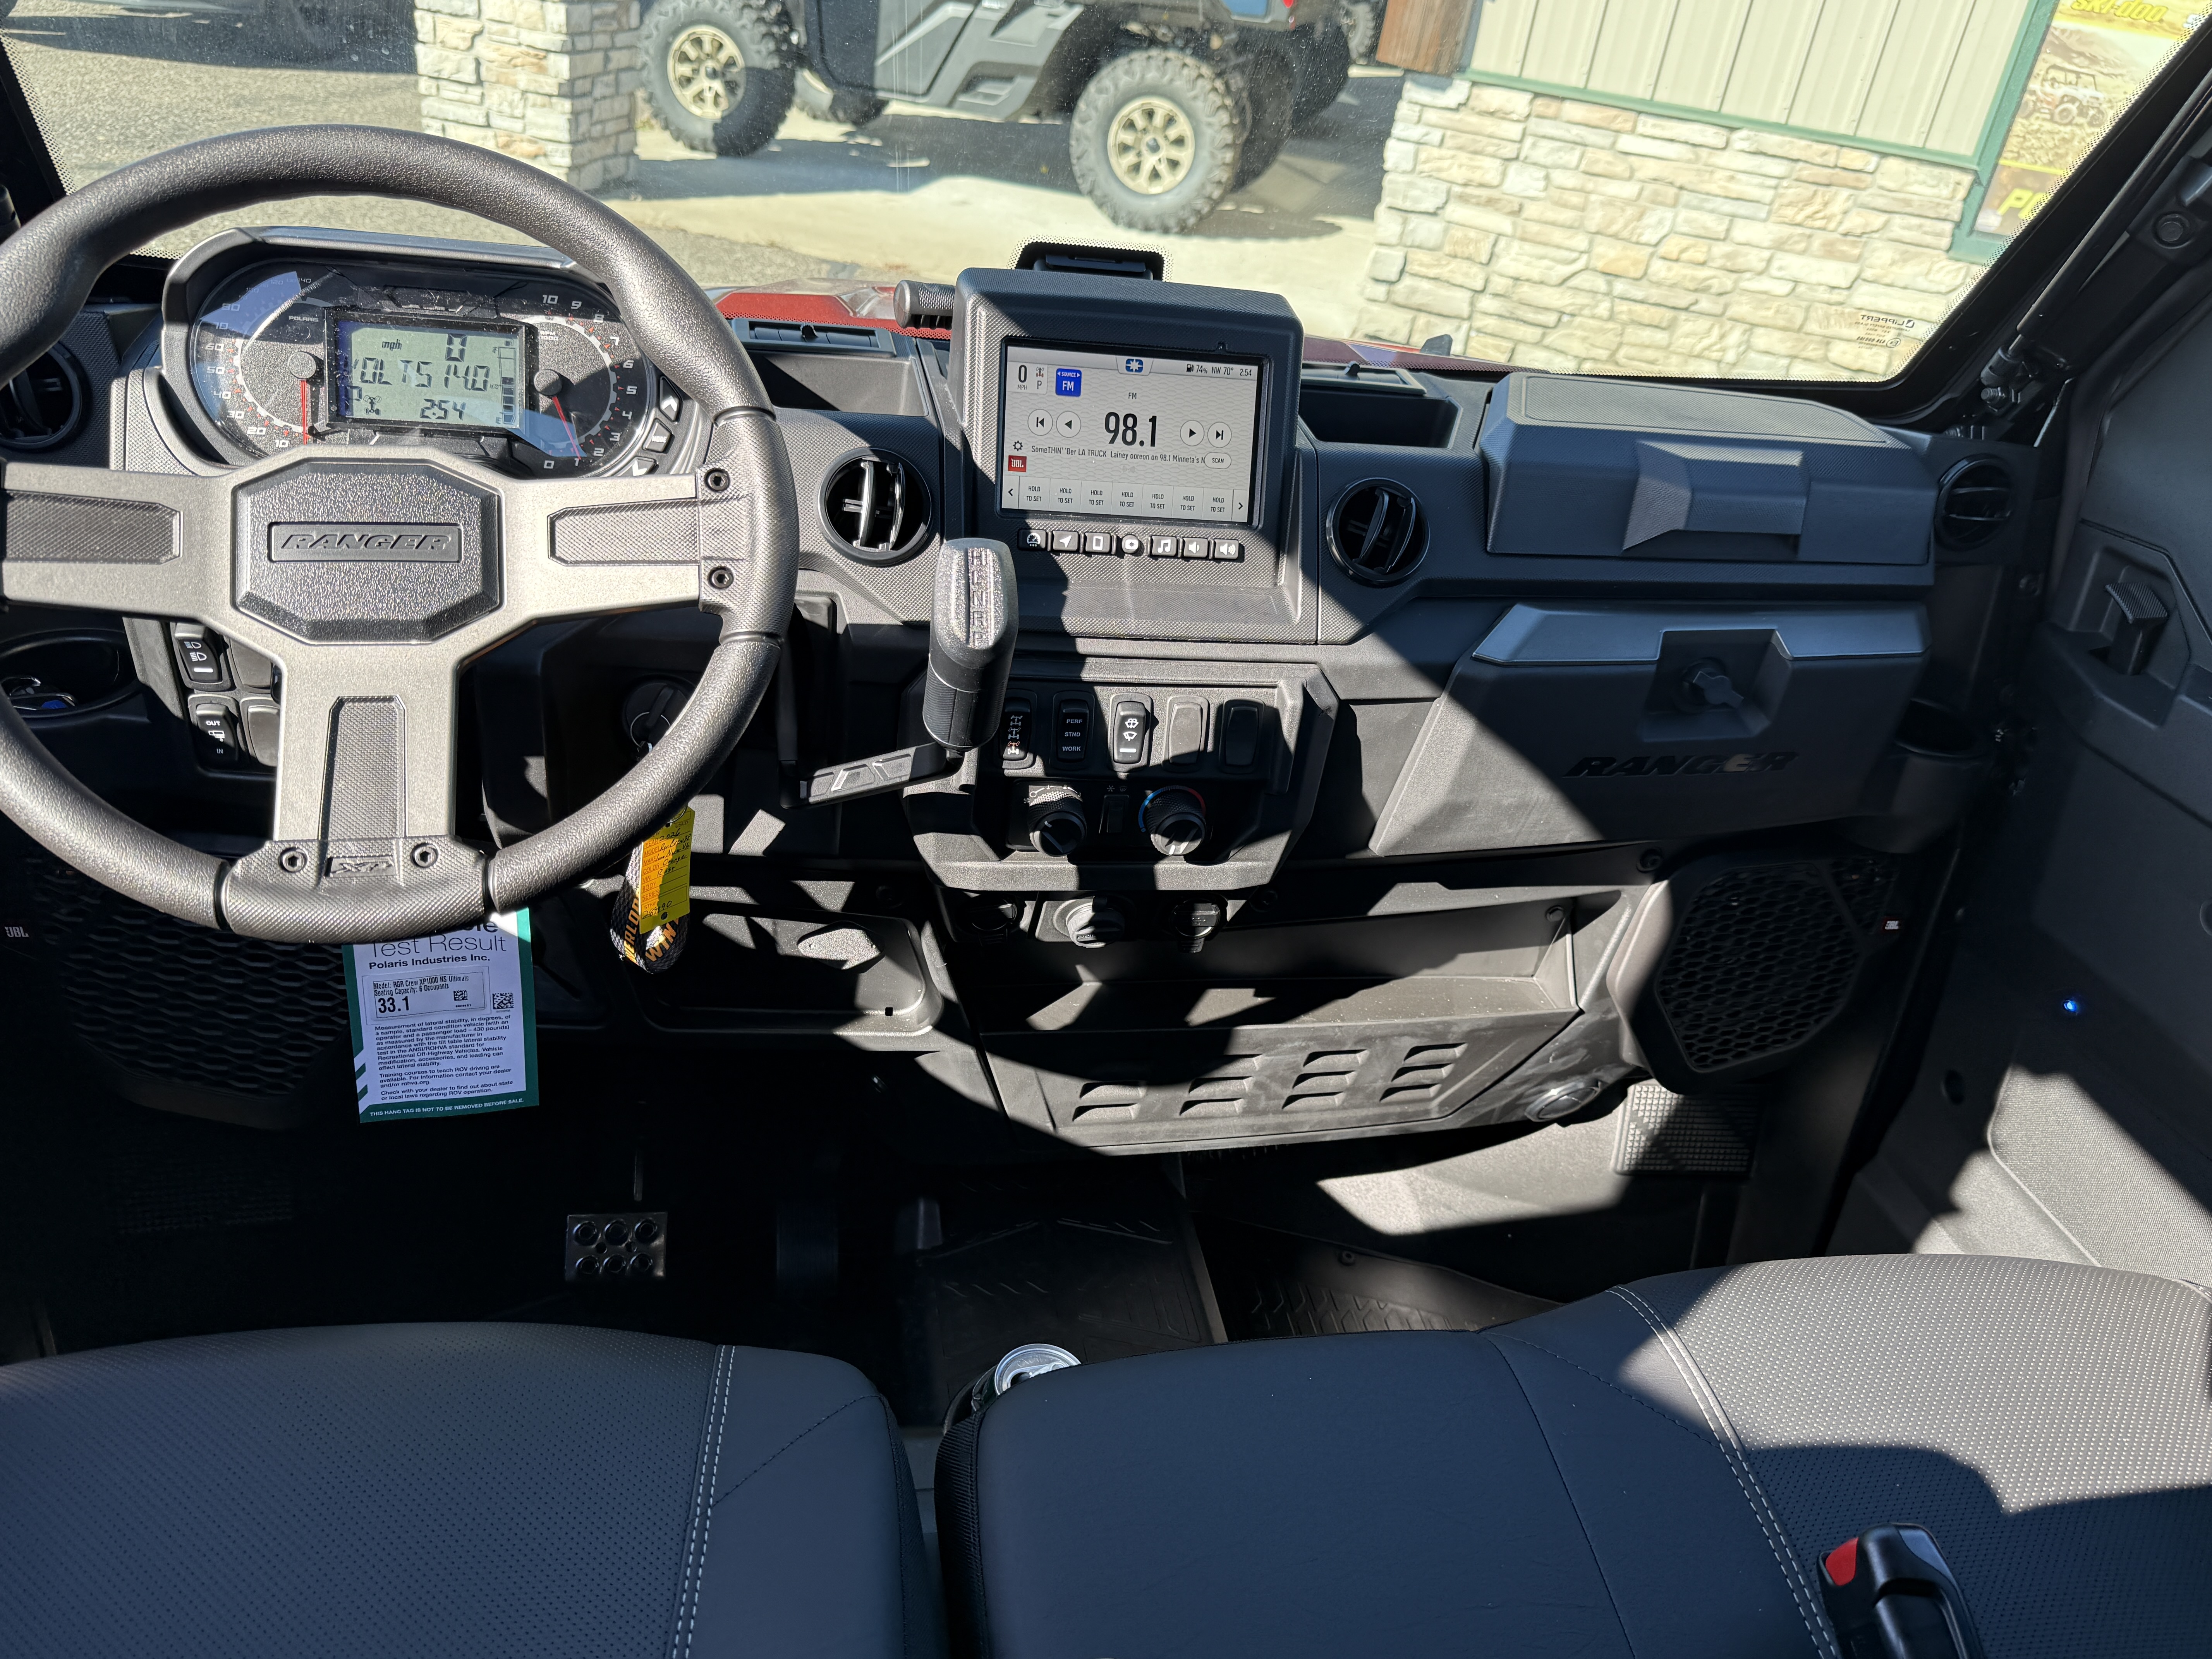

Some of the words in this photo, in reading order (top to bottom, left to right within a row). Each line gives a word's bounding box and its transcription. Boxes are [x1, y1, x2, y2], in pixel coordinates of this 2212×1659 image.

[543, 295, 558, 304] 10
[571, 301, 582, 309] 9
[593, 314, 604, 323] 8
[382, 339, 402, 351] mph
[610, 337, 620, 346] 7
[623, 360, 634, 369] 6
[206, 366, 225, 374] 50
[1018, 365, 1027, 383] 0
[1196, 365, 1207, 374] 74%
[1224, 367, 1234, 375] 70°
[626, 386, 637, 395] 5
[1037, 381, 1042, 390] P
[1062, 381, 1074, 391] FM
[213, 391, 232, 399] 40
[227, 410, 244, 419] 30
[622, 411, 632, 420] 4
[247, 426, 266, 435] 20
[1104, 411, 1157, 447] 98.1
[610, 432, 621, 441] 3
[651, 435, 667, 443] MODE
[593, 448, 605, 457] 2
[1087, 449, 1106, 457] TRUCK
[544, 460, 555, 469] 0
[281, 534, 452, 550] RANGER
[973, 550, 986, 566] H
[973, 570, 982, 586] L
[973, 591, 986, 606] N
[973, 611, 986, 626] R
[974, 631, 986, 646] P
[1562, 752, 1800, 778] RANGER
[646, 838, 658, 847] YEAR
[644, 847, 660, 857] MODEL
[644, 856, 656, 866] MAKE
[643, 863, 659, 874] COLOR
[643, 882, 656, 891] BODY
[642, 890, 659, 901] SERIES
[4, 926, 29, 937] JBL
[429, 933, 507, 952] Result
[369, 960, 408, 969] Polaris
[412, 955, 467, 966] Industries
[419, 976, 438, 985] XP1000
[395, 987, 417, 996] Capacity:
[424, 983, 449, 992] Occupants
[378, 996, 409, 1013] 33.1
